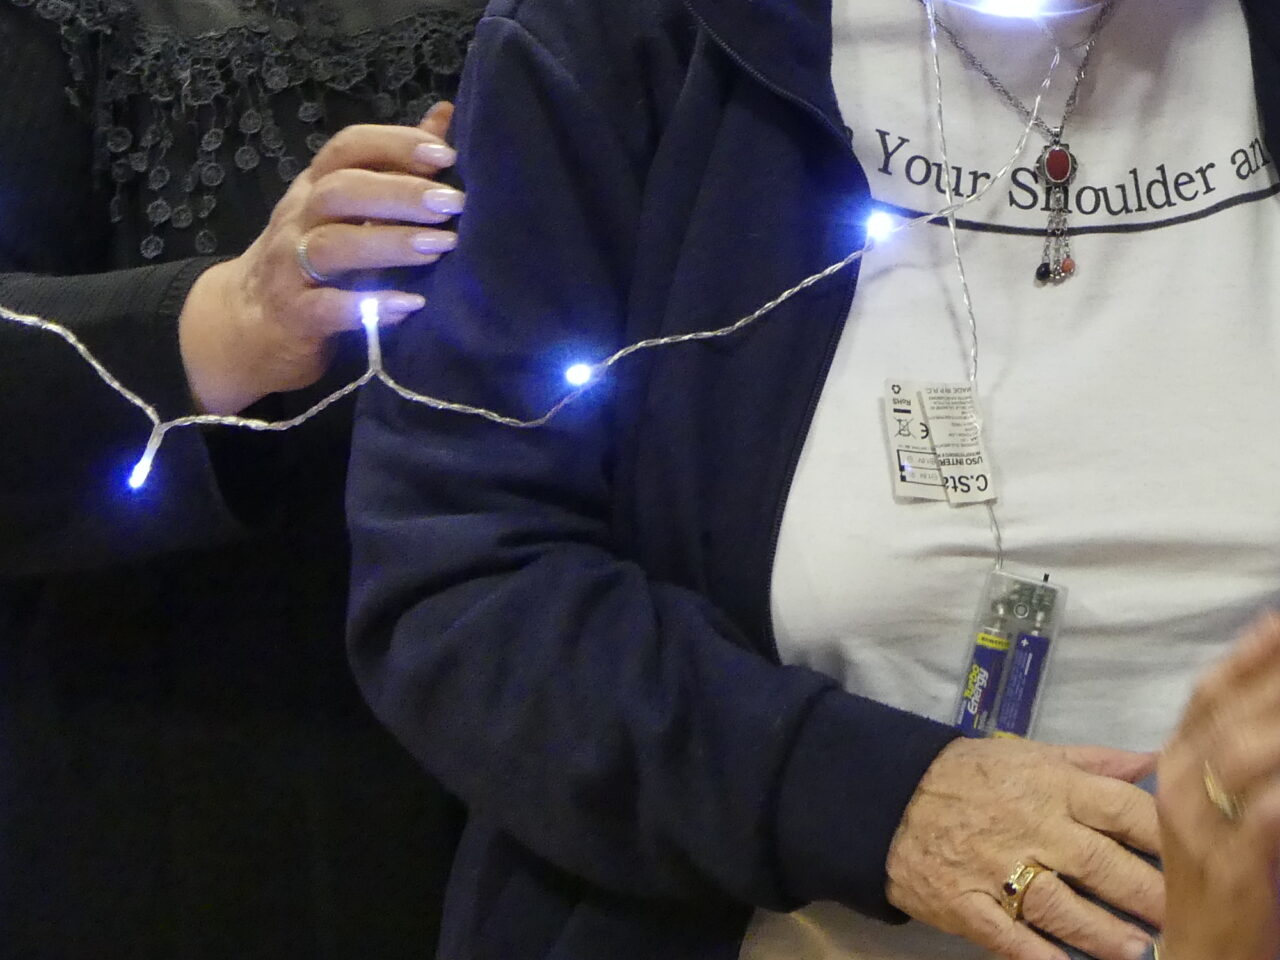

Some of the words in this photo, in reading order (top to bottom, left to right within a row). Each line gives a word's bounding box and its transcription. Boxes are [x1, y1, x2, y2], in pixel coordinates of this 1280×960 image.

[875, 129, 990, 198] Your
[1230, 137, 1270, 180] an
[967, 667, 989, 715] Energy
